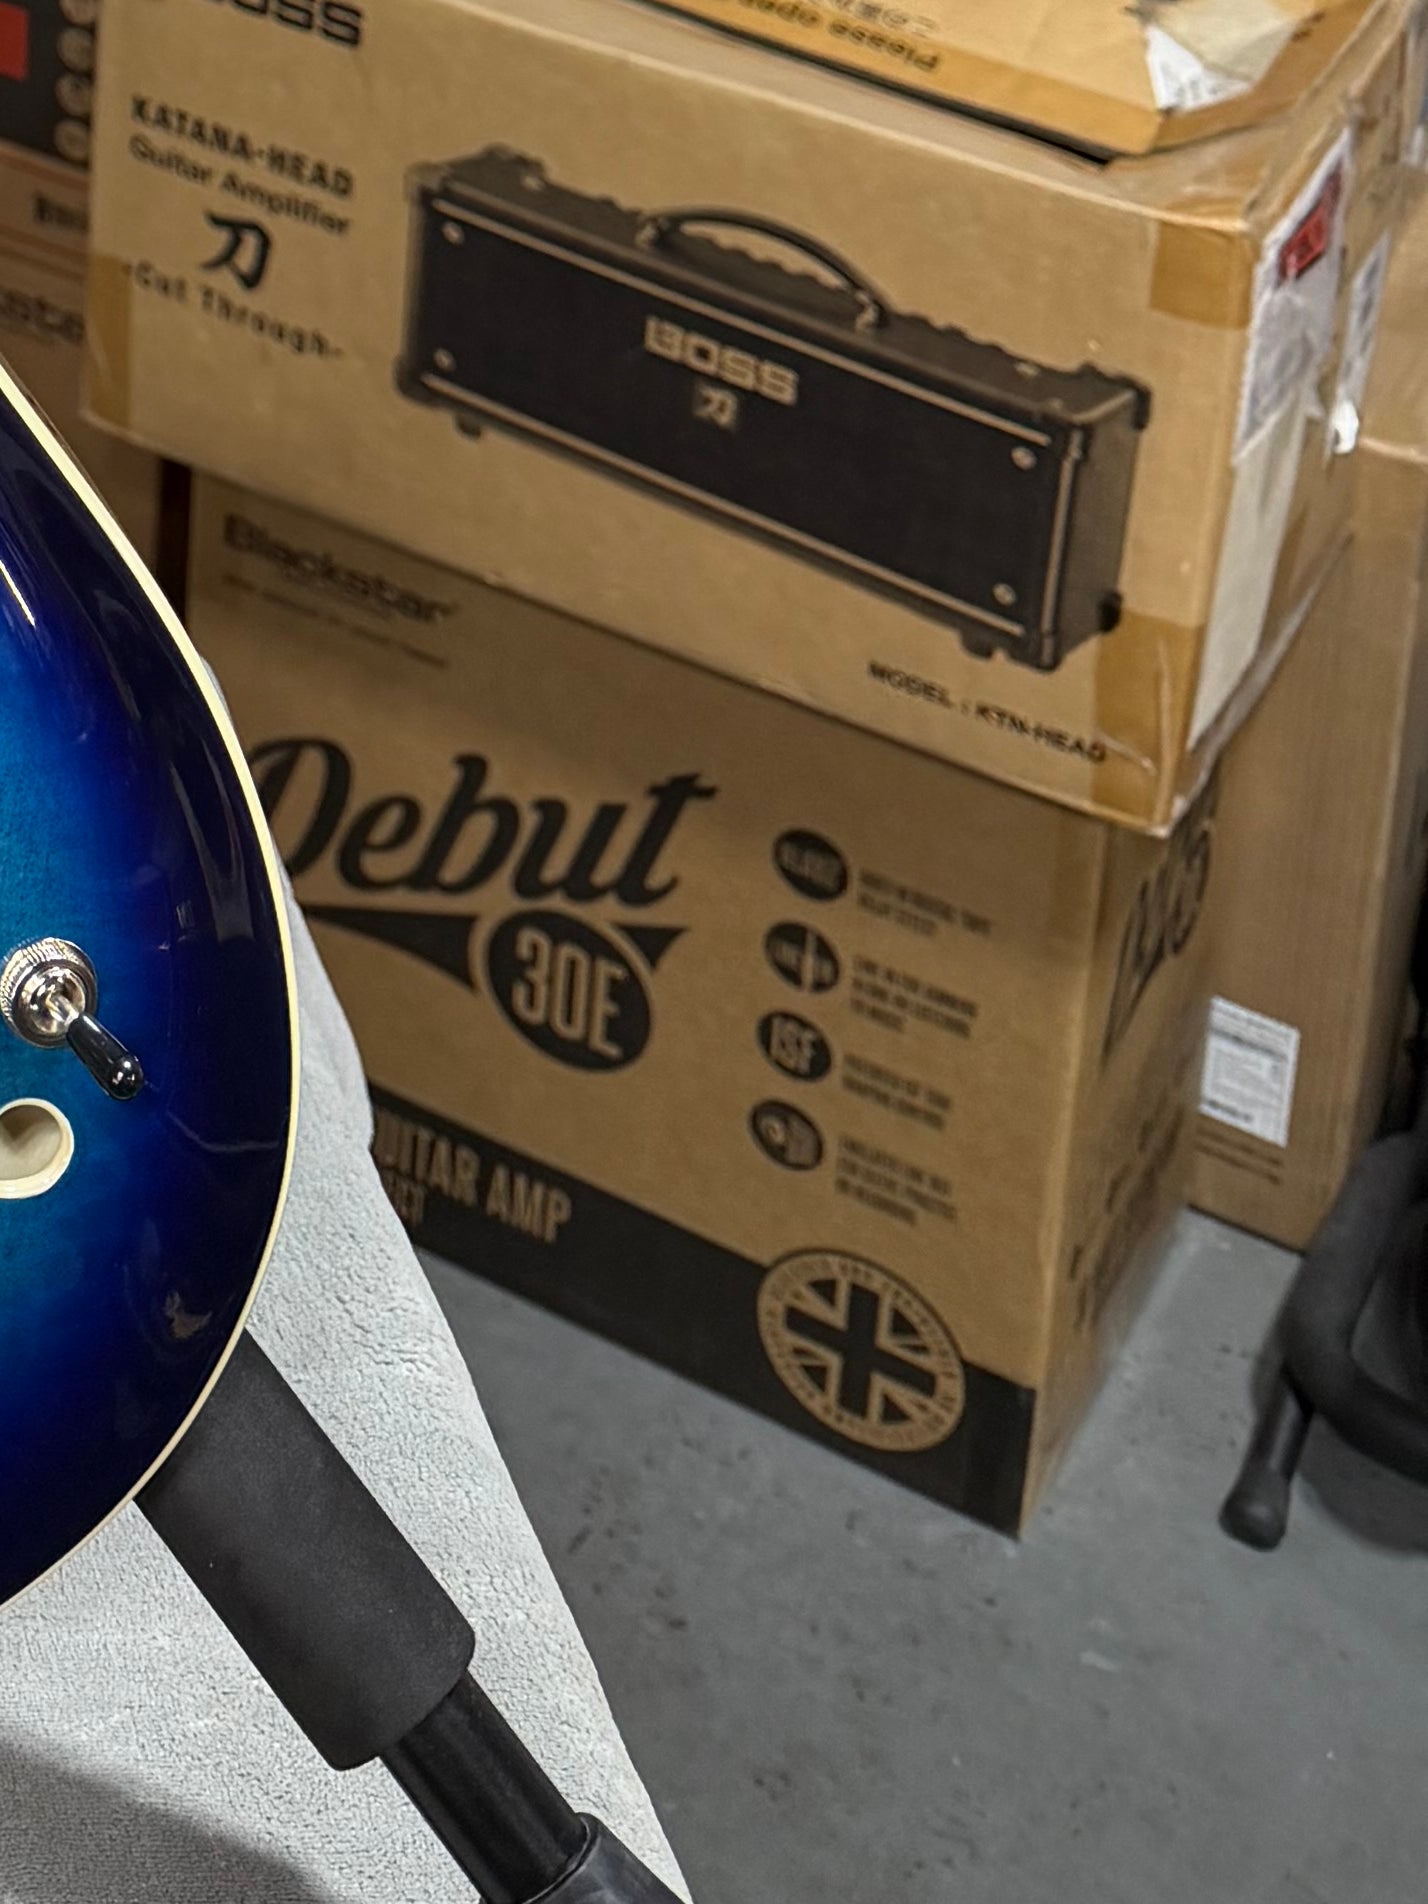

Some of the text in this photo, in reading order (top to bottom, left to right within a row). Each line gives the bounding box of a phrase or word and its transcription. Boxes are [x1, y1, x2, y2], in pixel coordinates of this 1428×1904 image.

[829, 18, 940, 72] Please
[128, 134, 350, 236] Guitar Amplifier
[644, 314, 800, 408] BOSS
[221, 512, 454, 624] Blackstar
[248, 736, 720, 909] Debut
[511, 925, 632, 1059] 30E
[374, 1106, 481, 1208] UITAR
[485, 1162, 573, 1244] AMP
